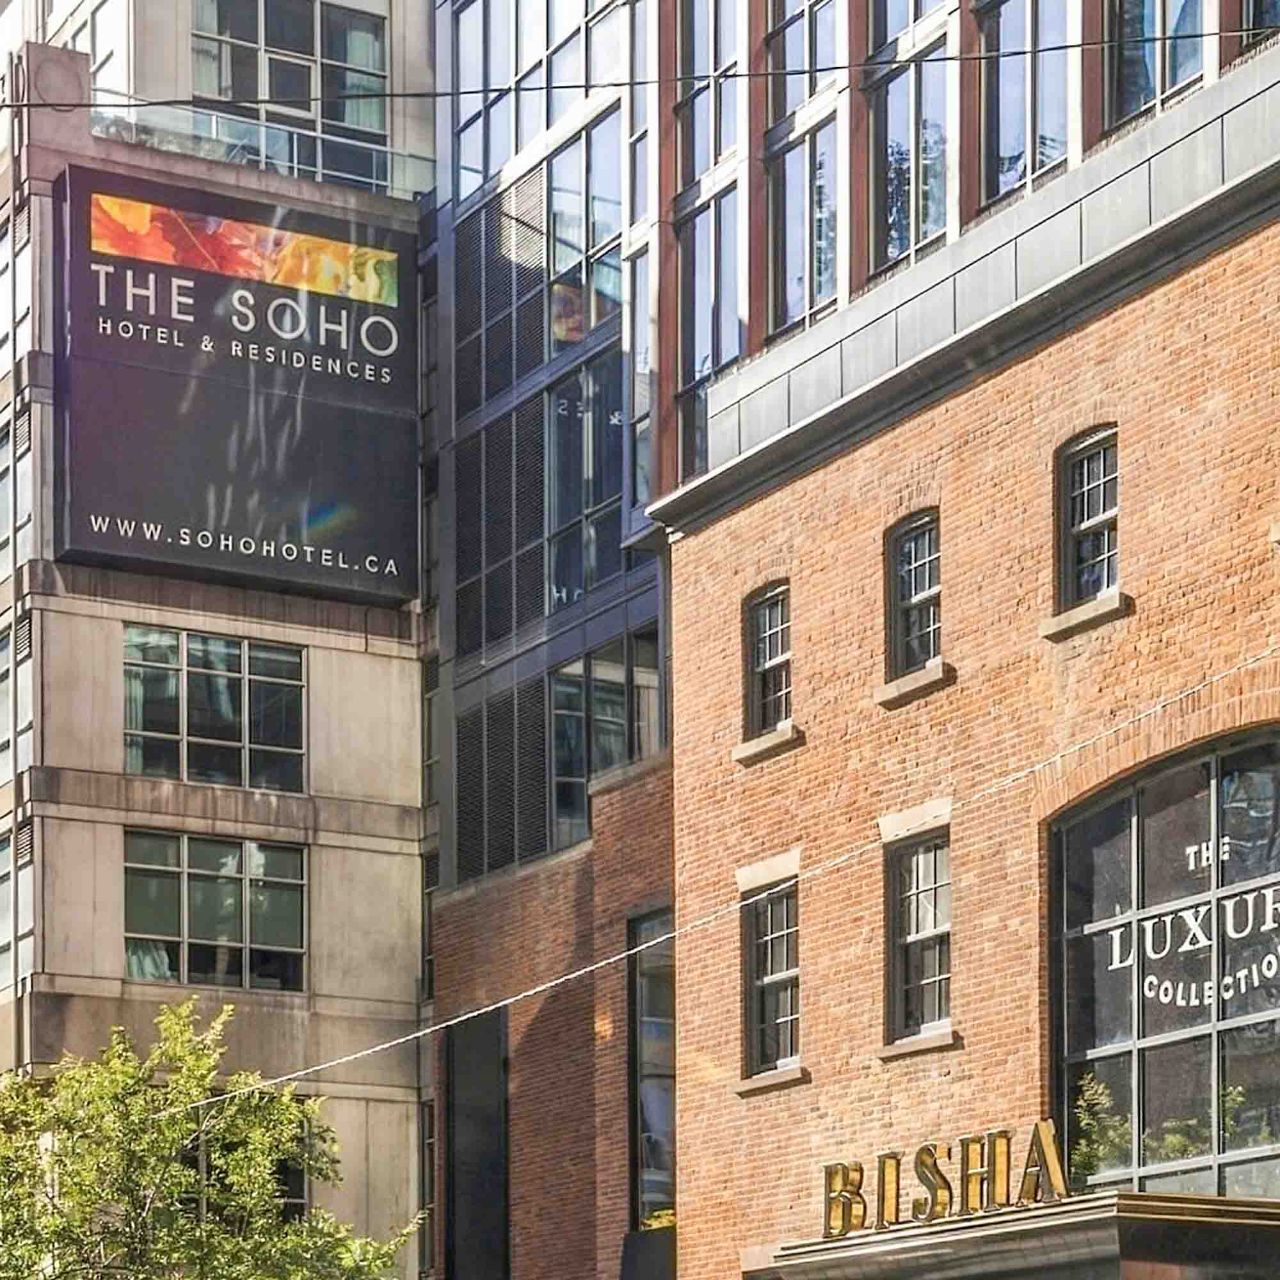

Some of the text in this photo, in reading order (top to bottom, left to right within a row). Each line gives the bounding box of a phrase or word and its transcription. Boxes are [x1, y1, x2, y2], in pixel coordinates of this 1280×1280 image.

[91, 264, 398, 357] THE SOHO
[99, 317, 392, 383] HOTEL & RESIDENCES
[91, 514, 399, 576] WWW.SOHOHOTEL.CA
[1185, 836, 1230, 870] THE
[823, 1118, 1070, 1239] BISHA
